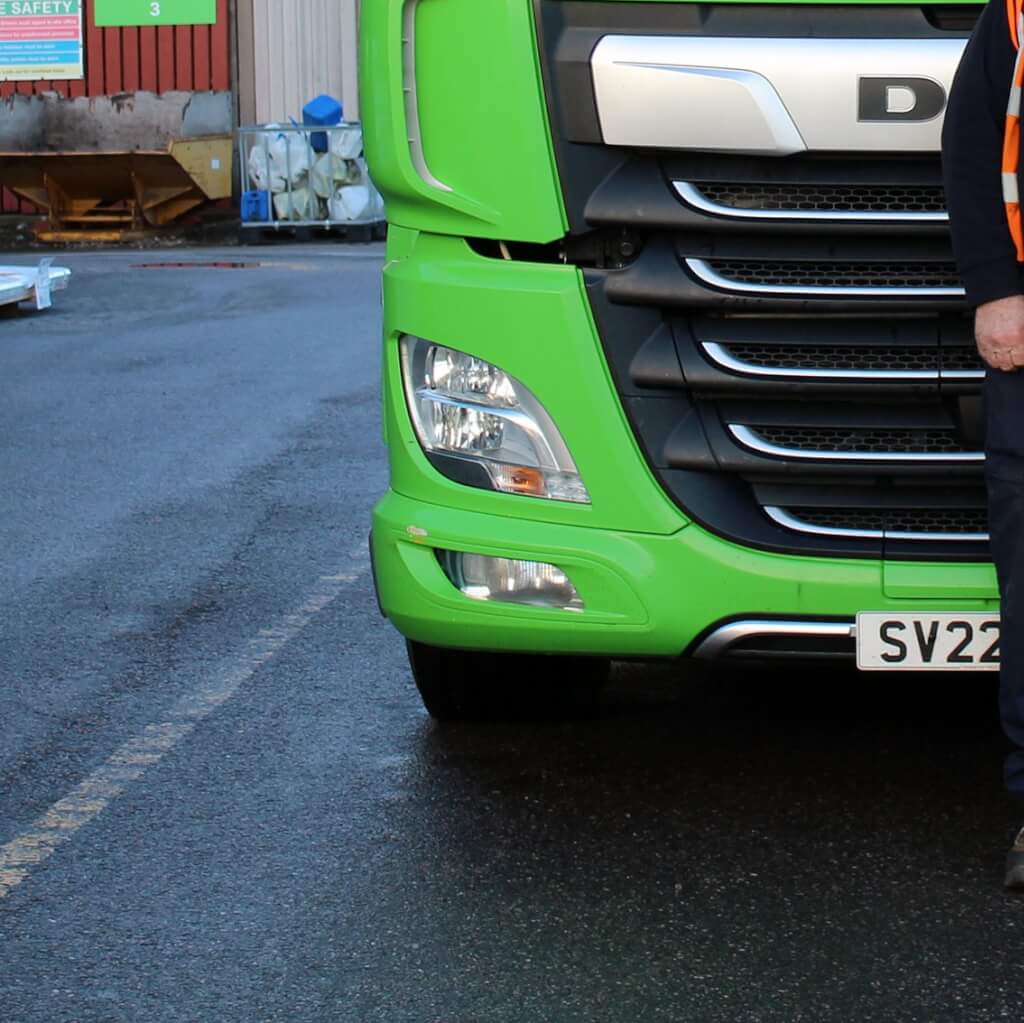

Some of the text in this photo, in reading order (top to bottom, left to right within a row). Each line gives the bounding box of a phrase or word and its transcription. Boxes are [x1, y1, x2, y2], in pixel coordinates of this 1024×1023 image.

[11, 0, 73, 15] SAFETY
[150, 1, 161, 17] 3
[879, 620, 1001, 664] SV22
